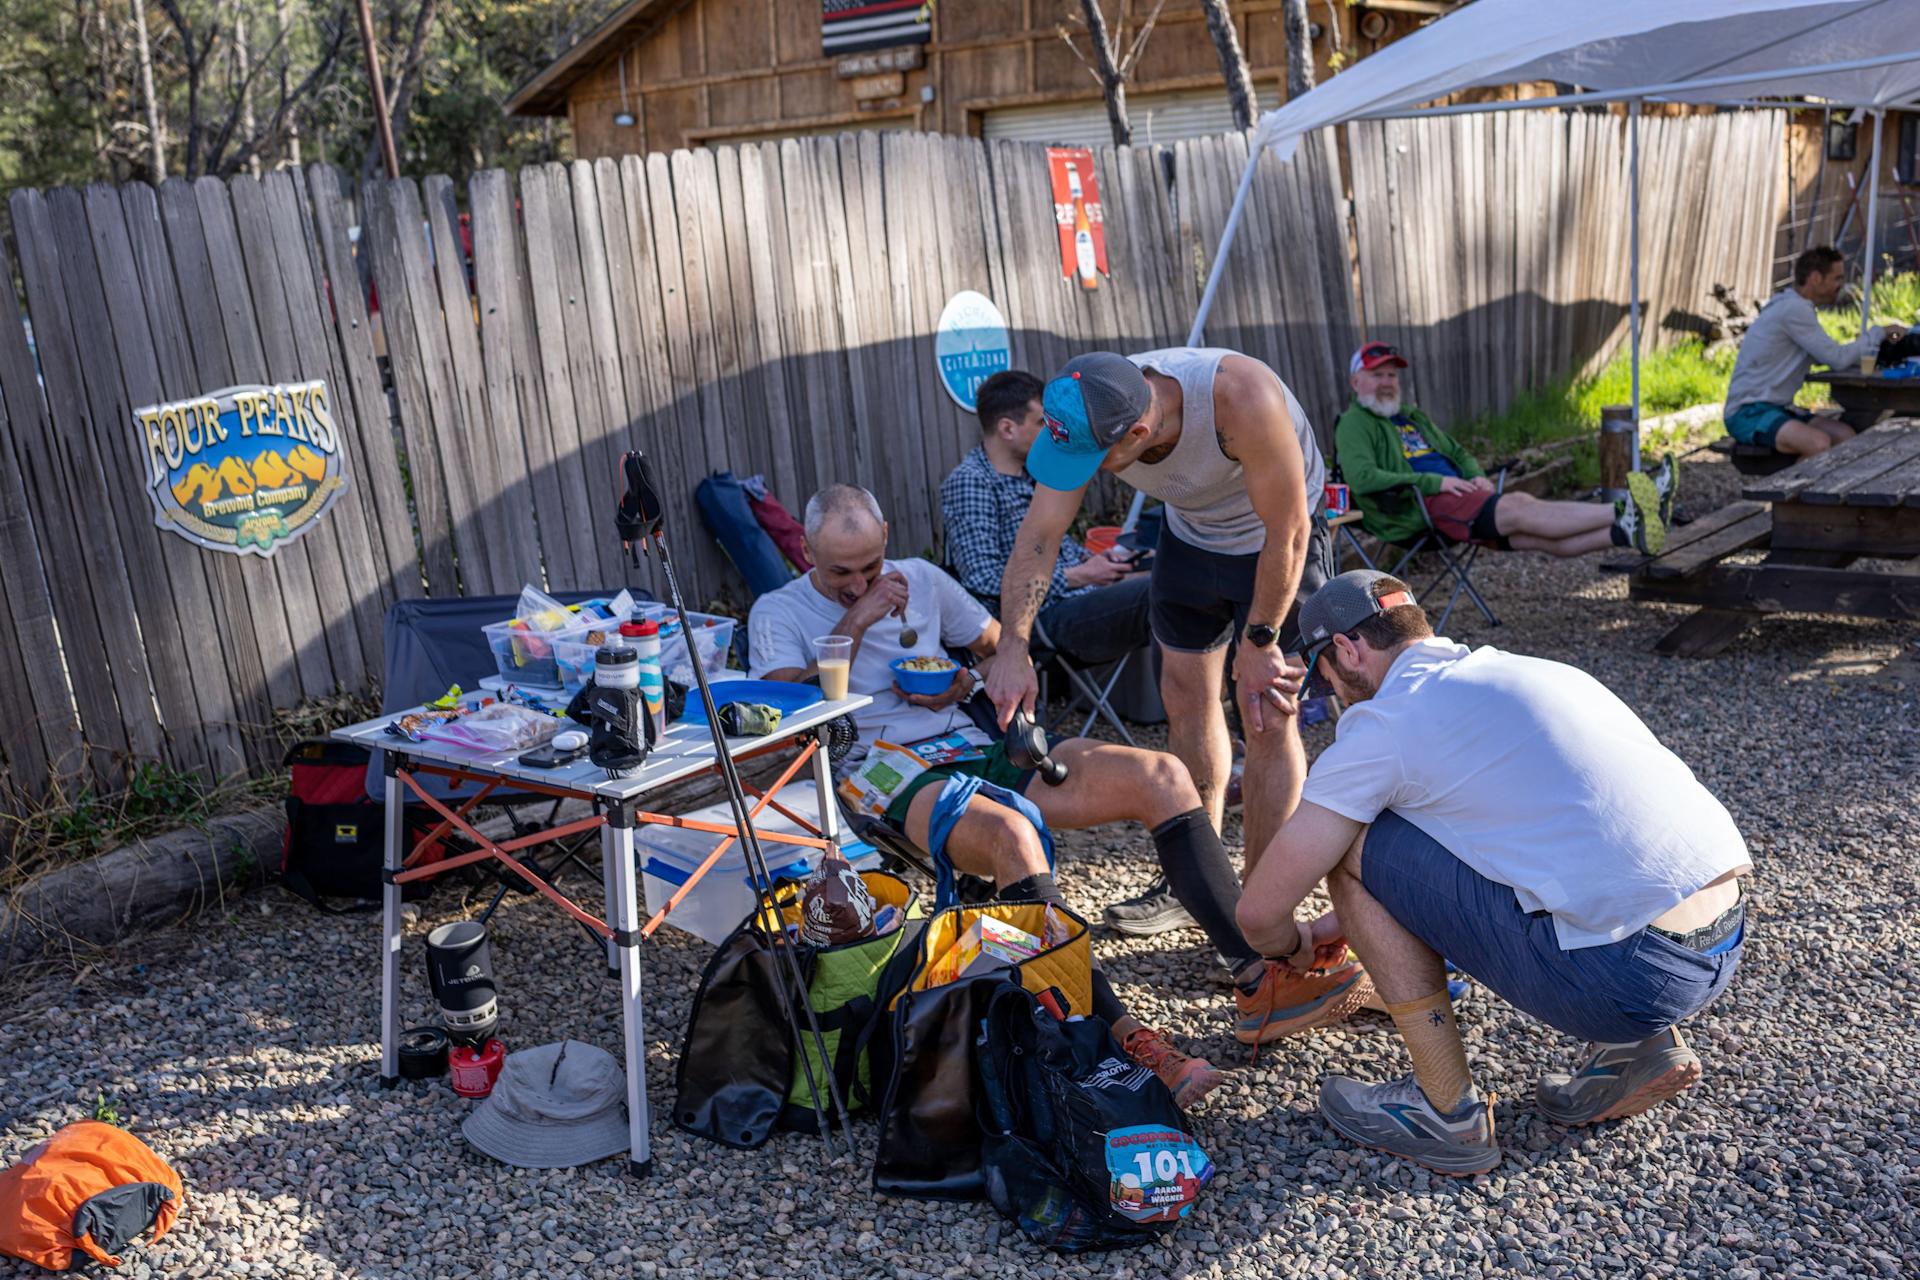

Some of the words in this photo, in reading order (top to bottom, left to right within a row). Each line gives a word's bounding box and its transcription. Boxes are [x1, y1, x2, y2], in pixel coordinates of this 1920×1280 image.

[134, 399, 229, 488] FOUR
[232, 382, 336, 454] PEAKS
[203, 494, 255, 518] Brewing
[256, 484, 308, 508] Company
[1133, 1150, 1197, 1183] 101
[1150, 1194, 1185, 1204] WAGNER
[1154, 1185, 1183, 1195] AARON
